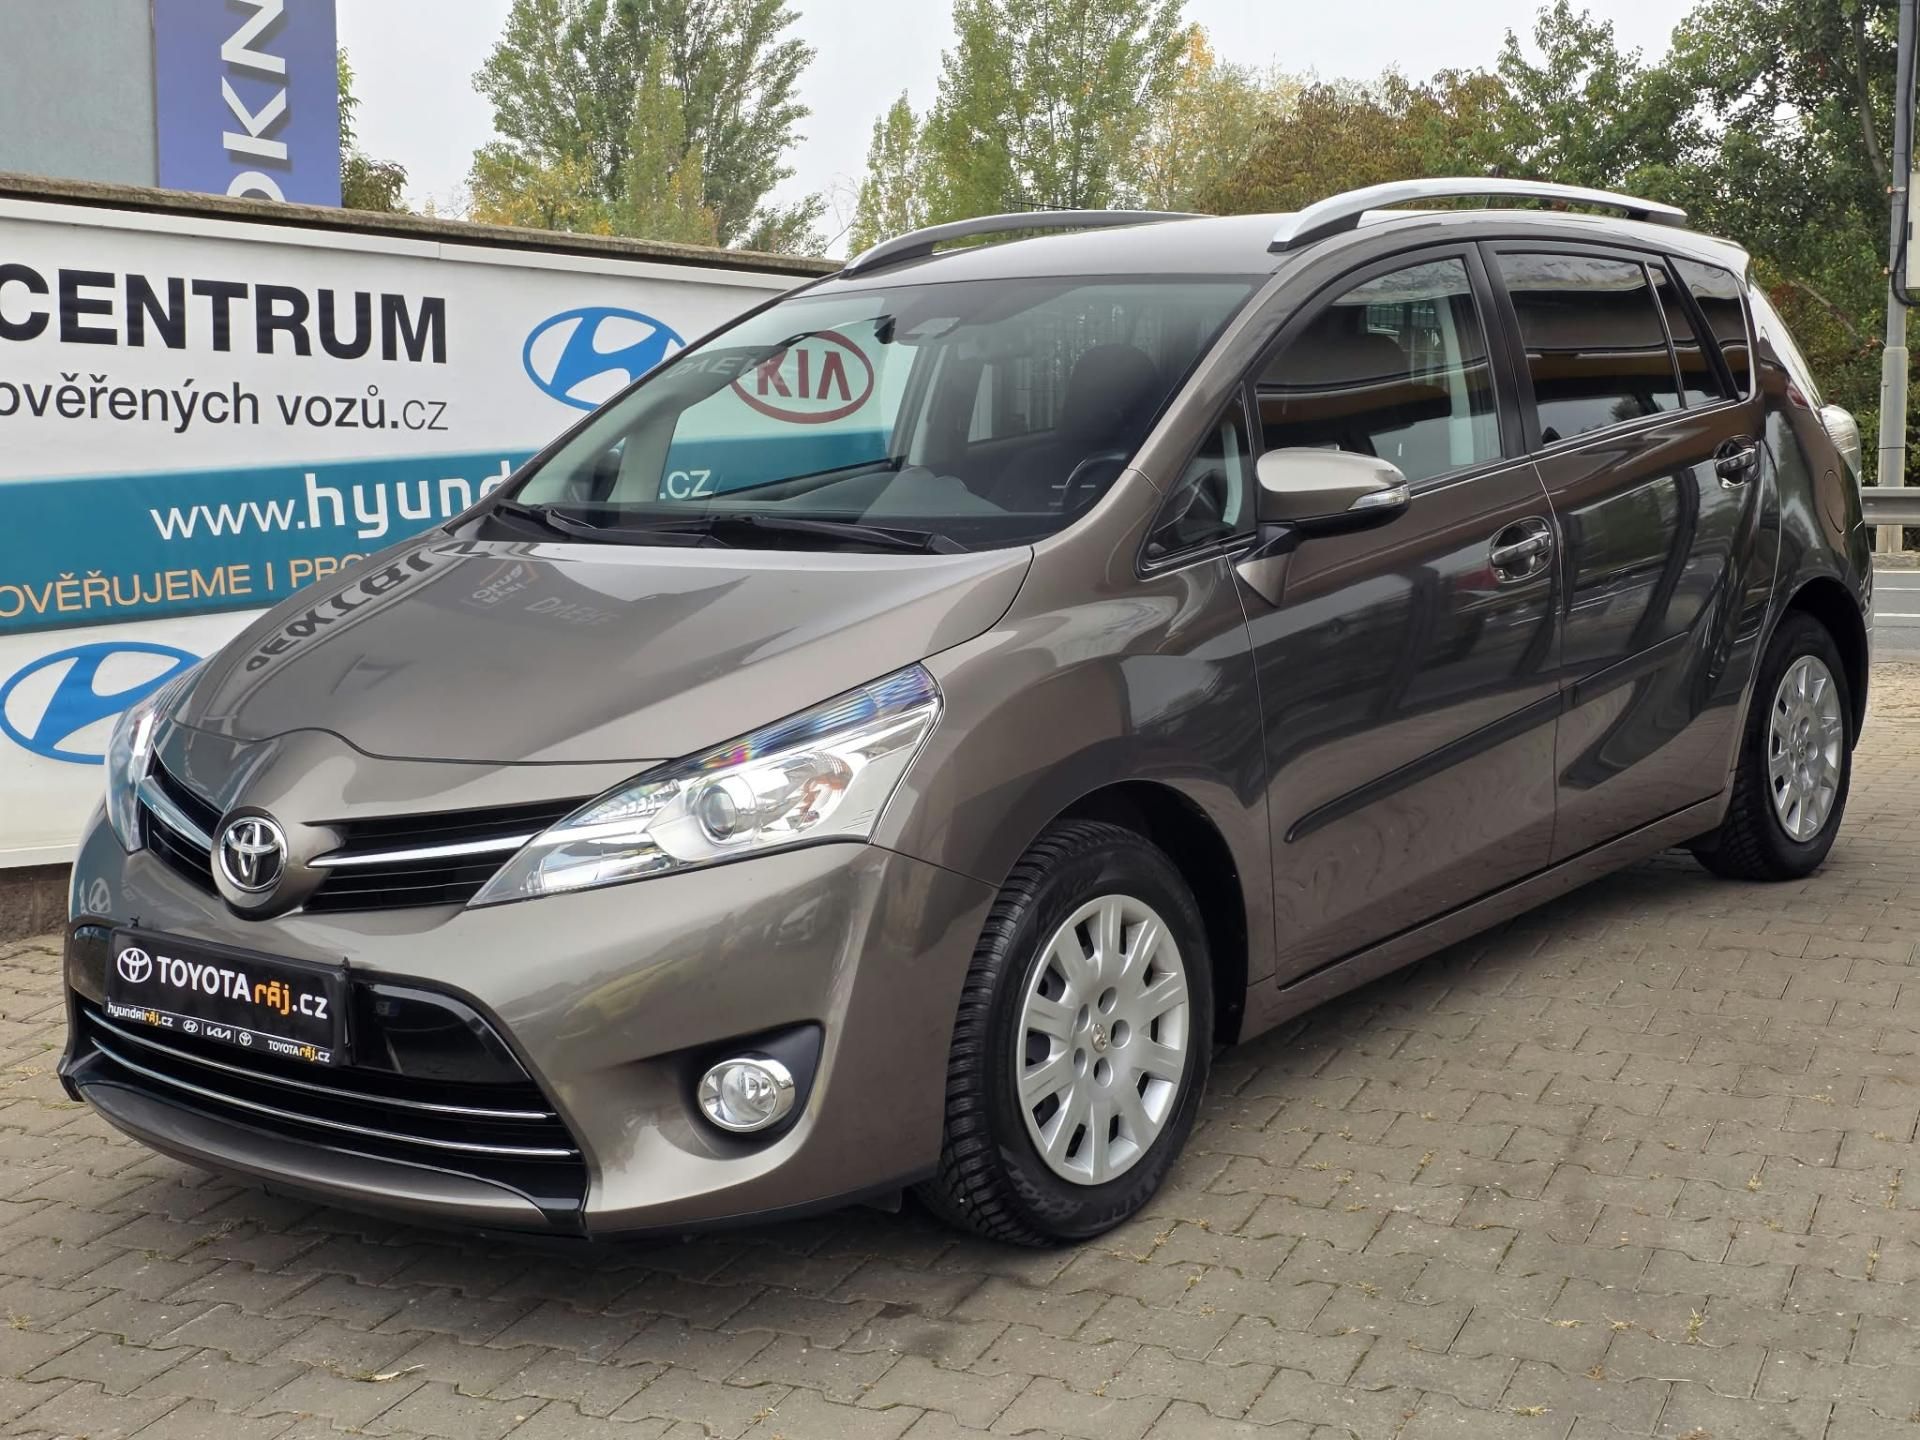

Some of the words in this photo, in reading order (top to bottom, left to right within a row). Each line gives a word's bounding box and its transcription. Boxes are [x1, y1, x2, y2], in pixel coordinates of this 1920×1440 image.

[0, 263, 447, 363] CENTRUM
[0, 372, 259, 433] ověřených
[277, 384, 449, 431] vozů.cz
[757, 348, 852, 401] KIA
[0, 564, 252, 618] OVĚŘUJEME
